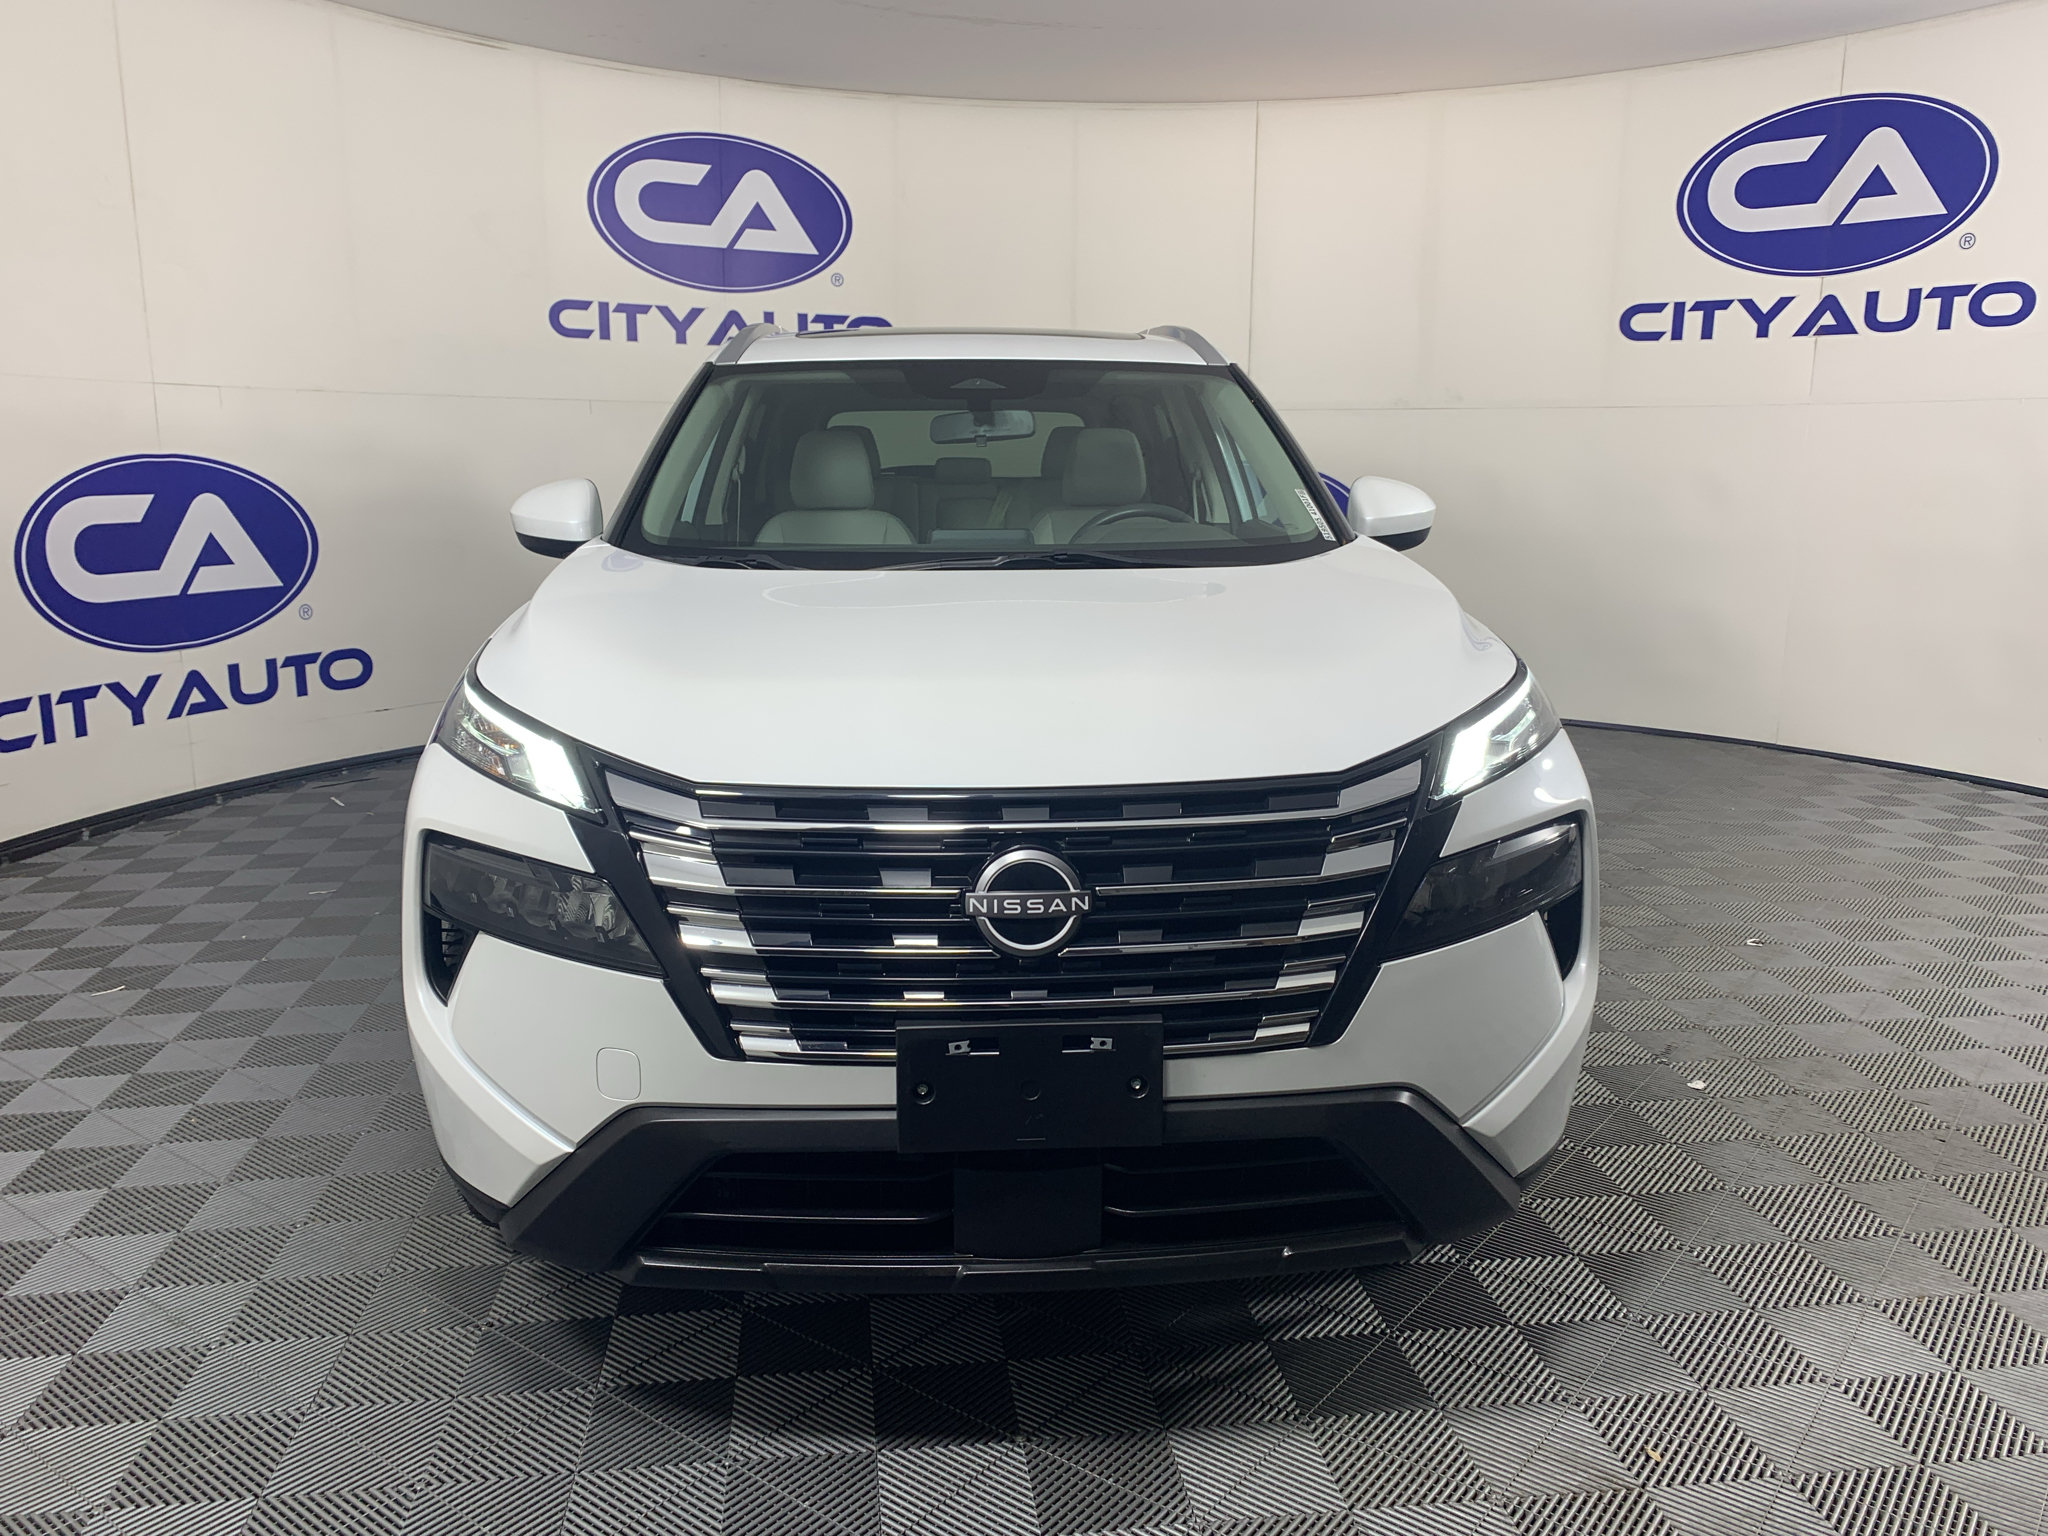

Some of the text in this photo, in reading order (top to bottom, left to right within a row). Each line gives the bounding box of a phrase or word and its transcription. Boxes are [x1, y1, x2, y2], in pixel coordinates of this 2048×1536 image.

[614, 158, 820, 255] CA
[1707, 126, 1948, 233] CA
[45, 492, 284, 603] CA
[969, 895, 1089, 914] NISSAN
